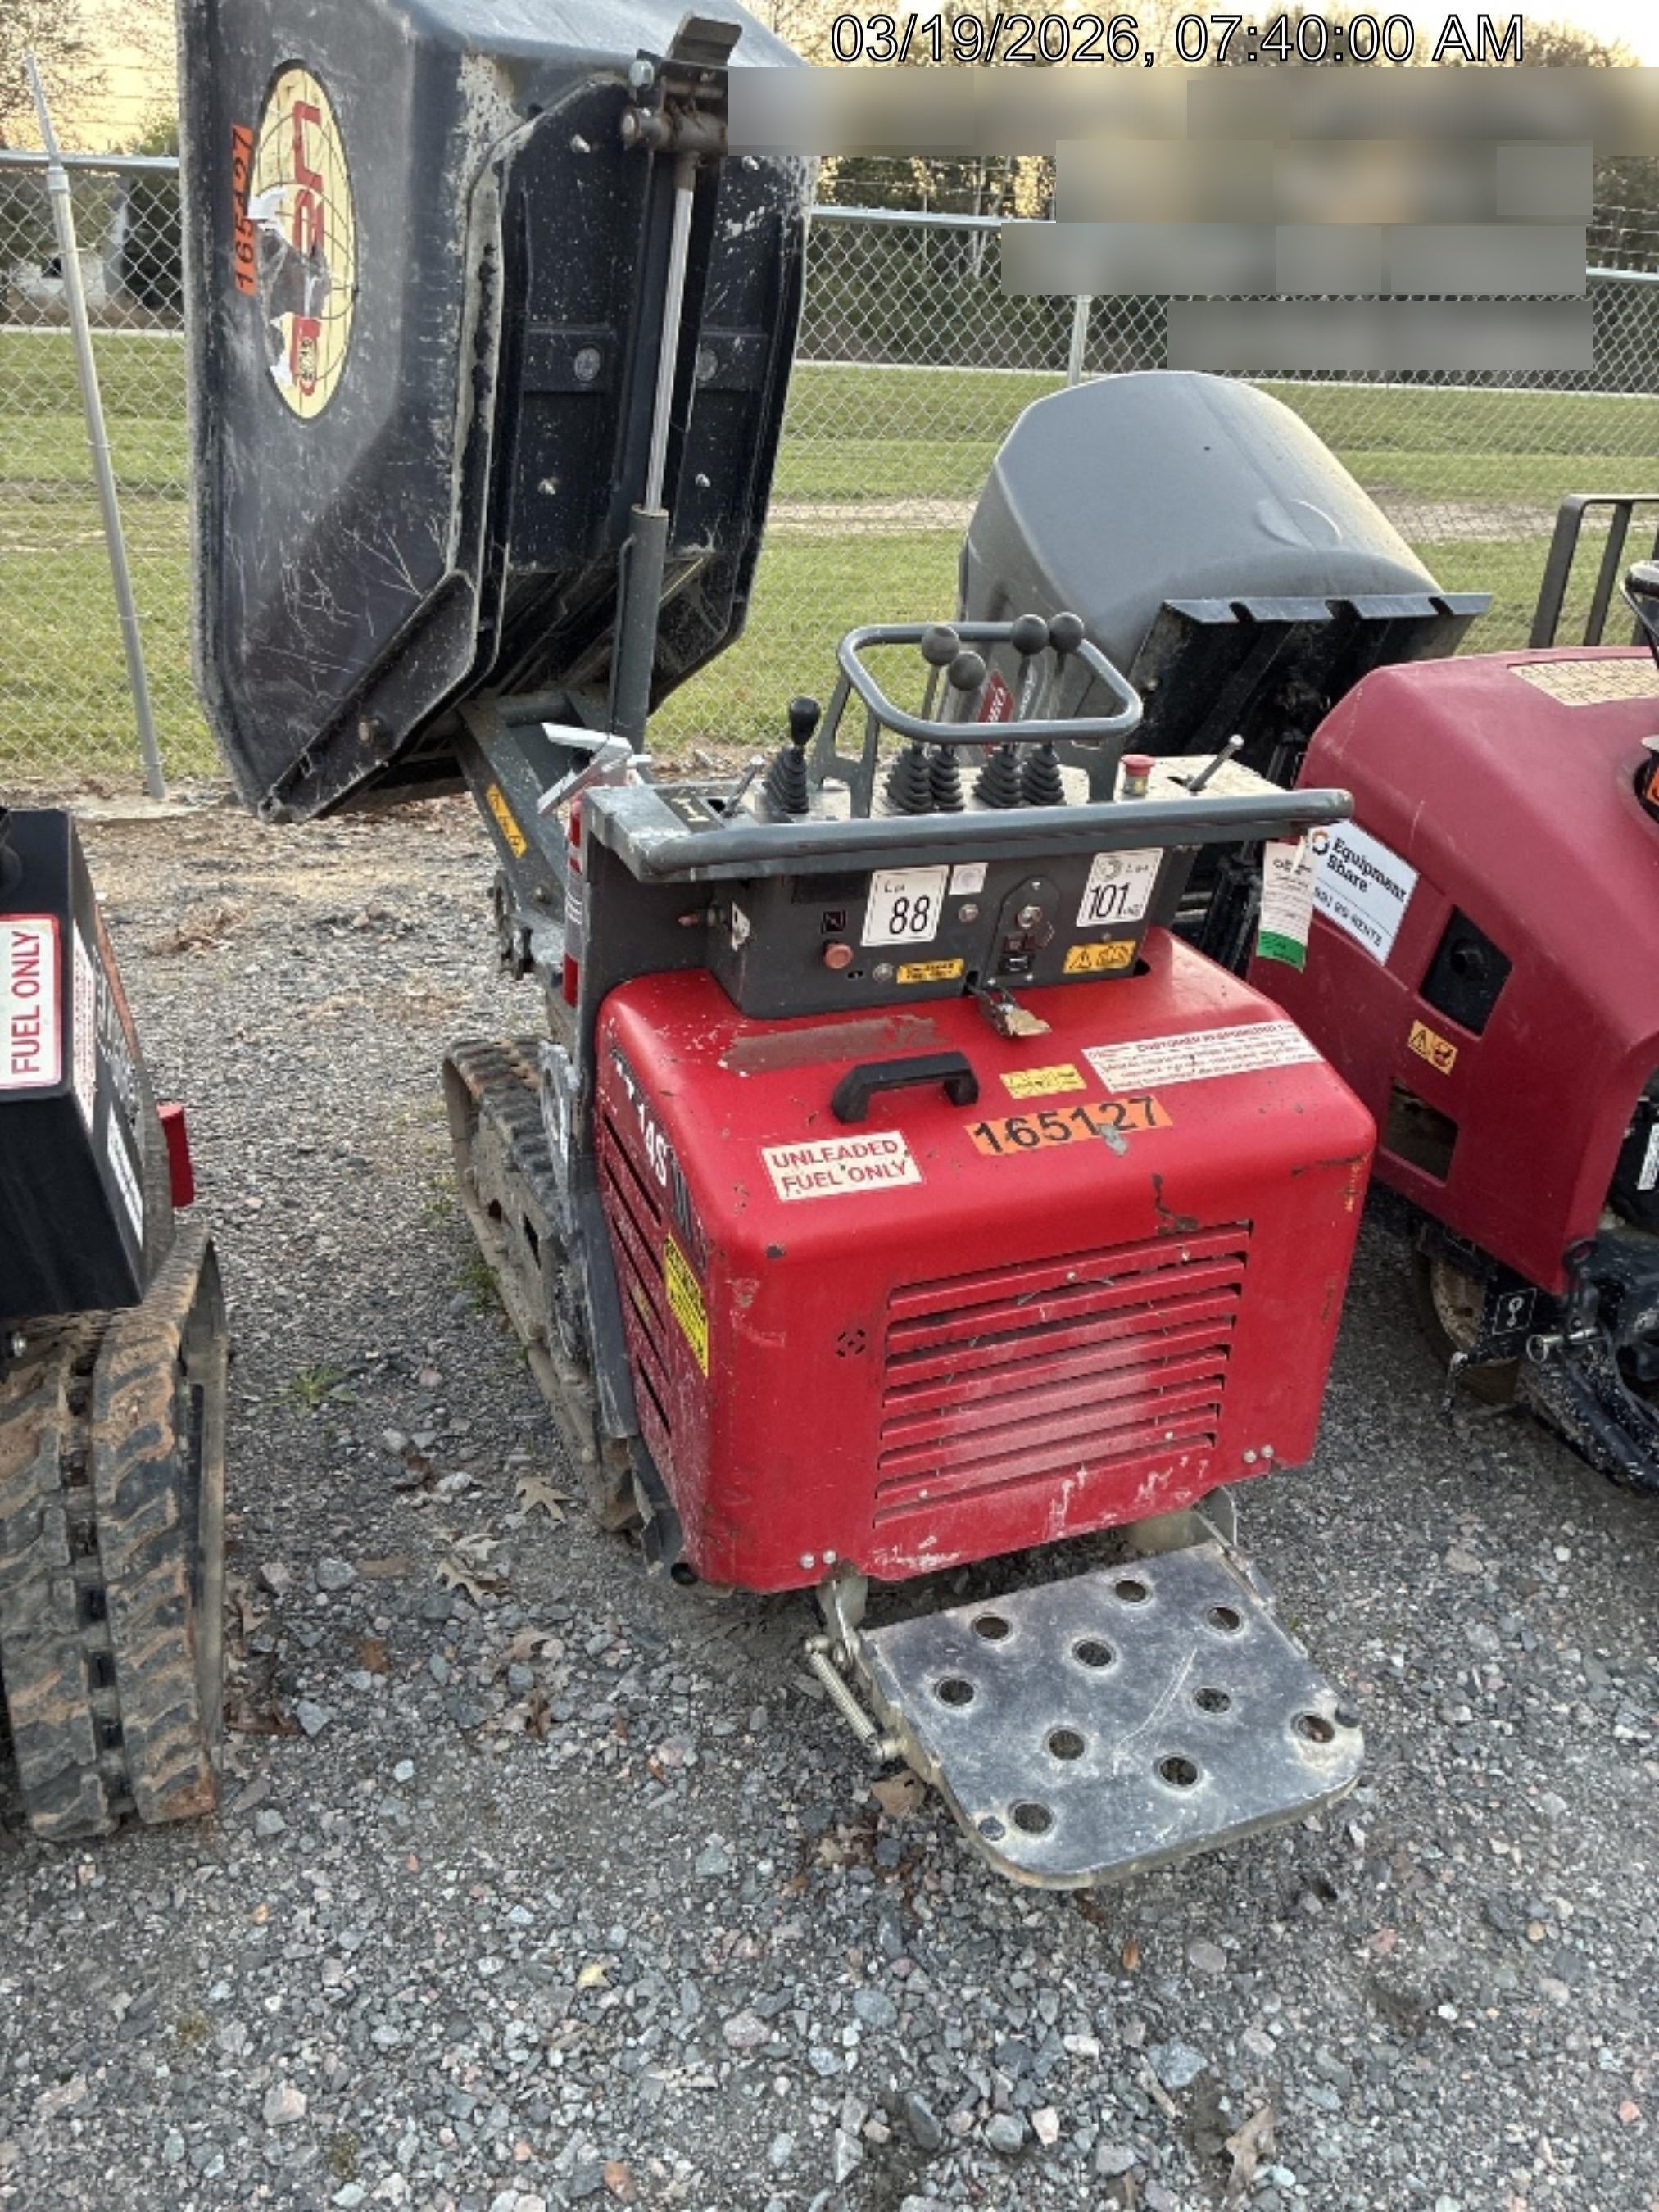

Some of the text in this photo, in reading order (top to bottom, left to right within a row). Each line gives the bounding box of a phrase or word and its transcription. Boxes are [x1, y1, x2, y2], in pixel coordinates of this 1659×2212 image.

[1327, 855, 1368, 893] Share
[1332, 836, 1407, 904] Equipment
[889, 895, 931, 935] 88
[1088, 882, 1130, 921] 101
[11, 931, 40, 1075] FUEL ONLY
[973, 1095, 1157, 1153] 165127
[771, 1140, 899, 1168] UNLEADED
[782, 1159, 908, 1193] FUEL ONLY
